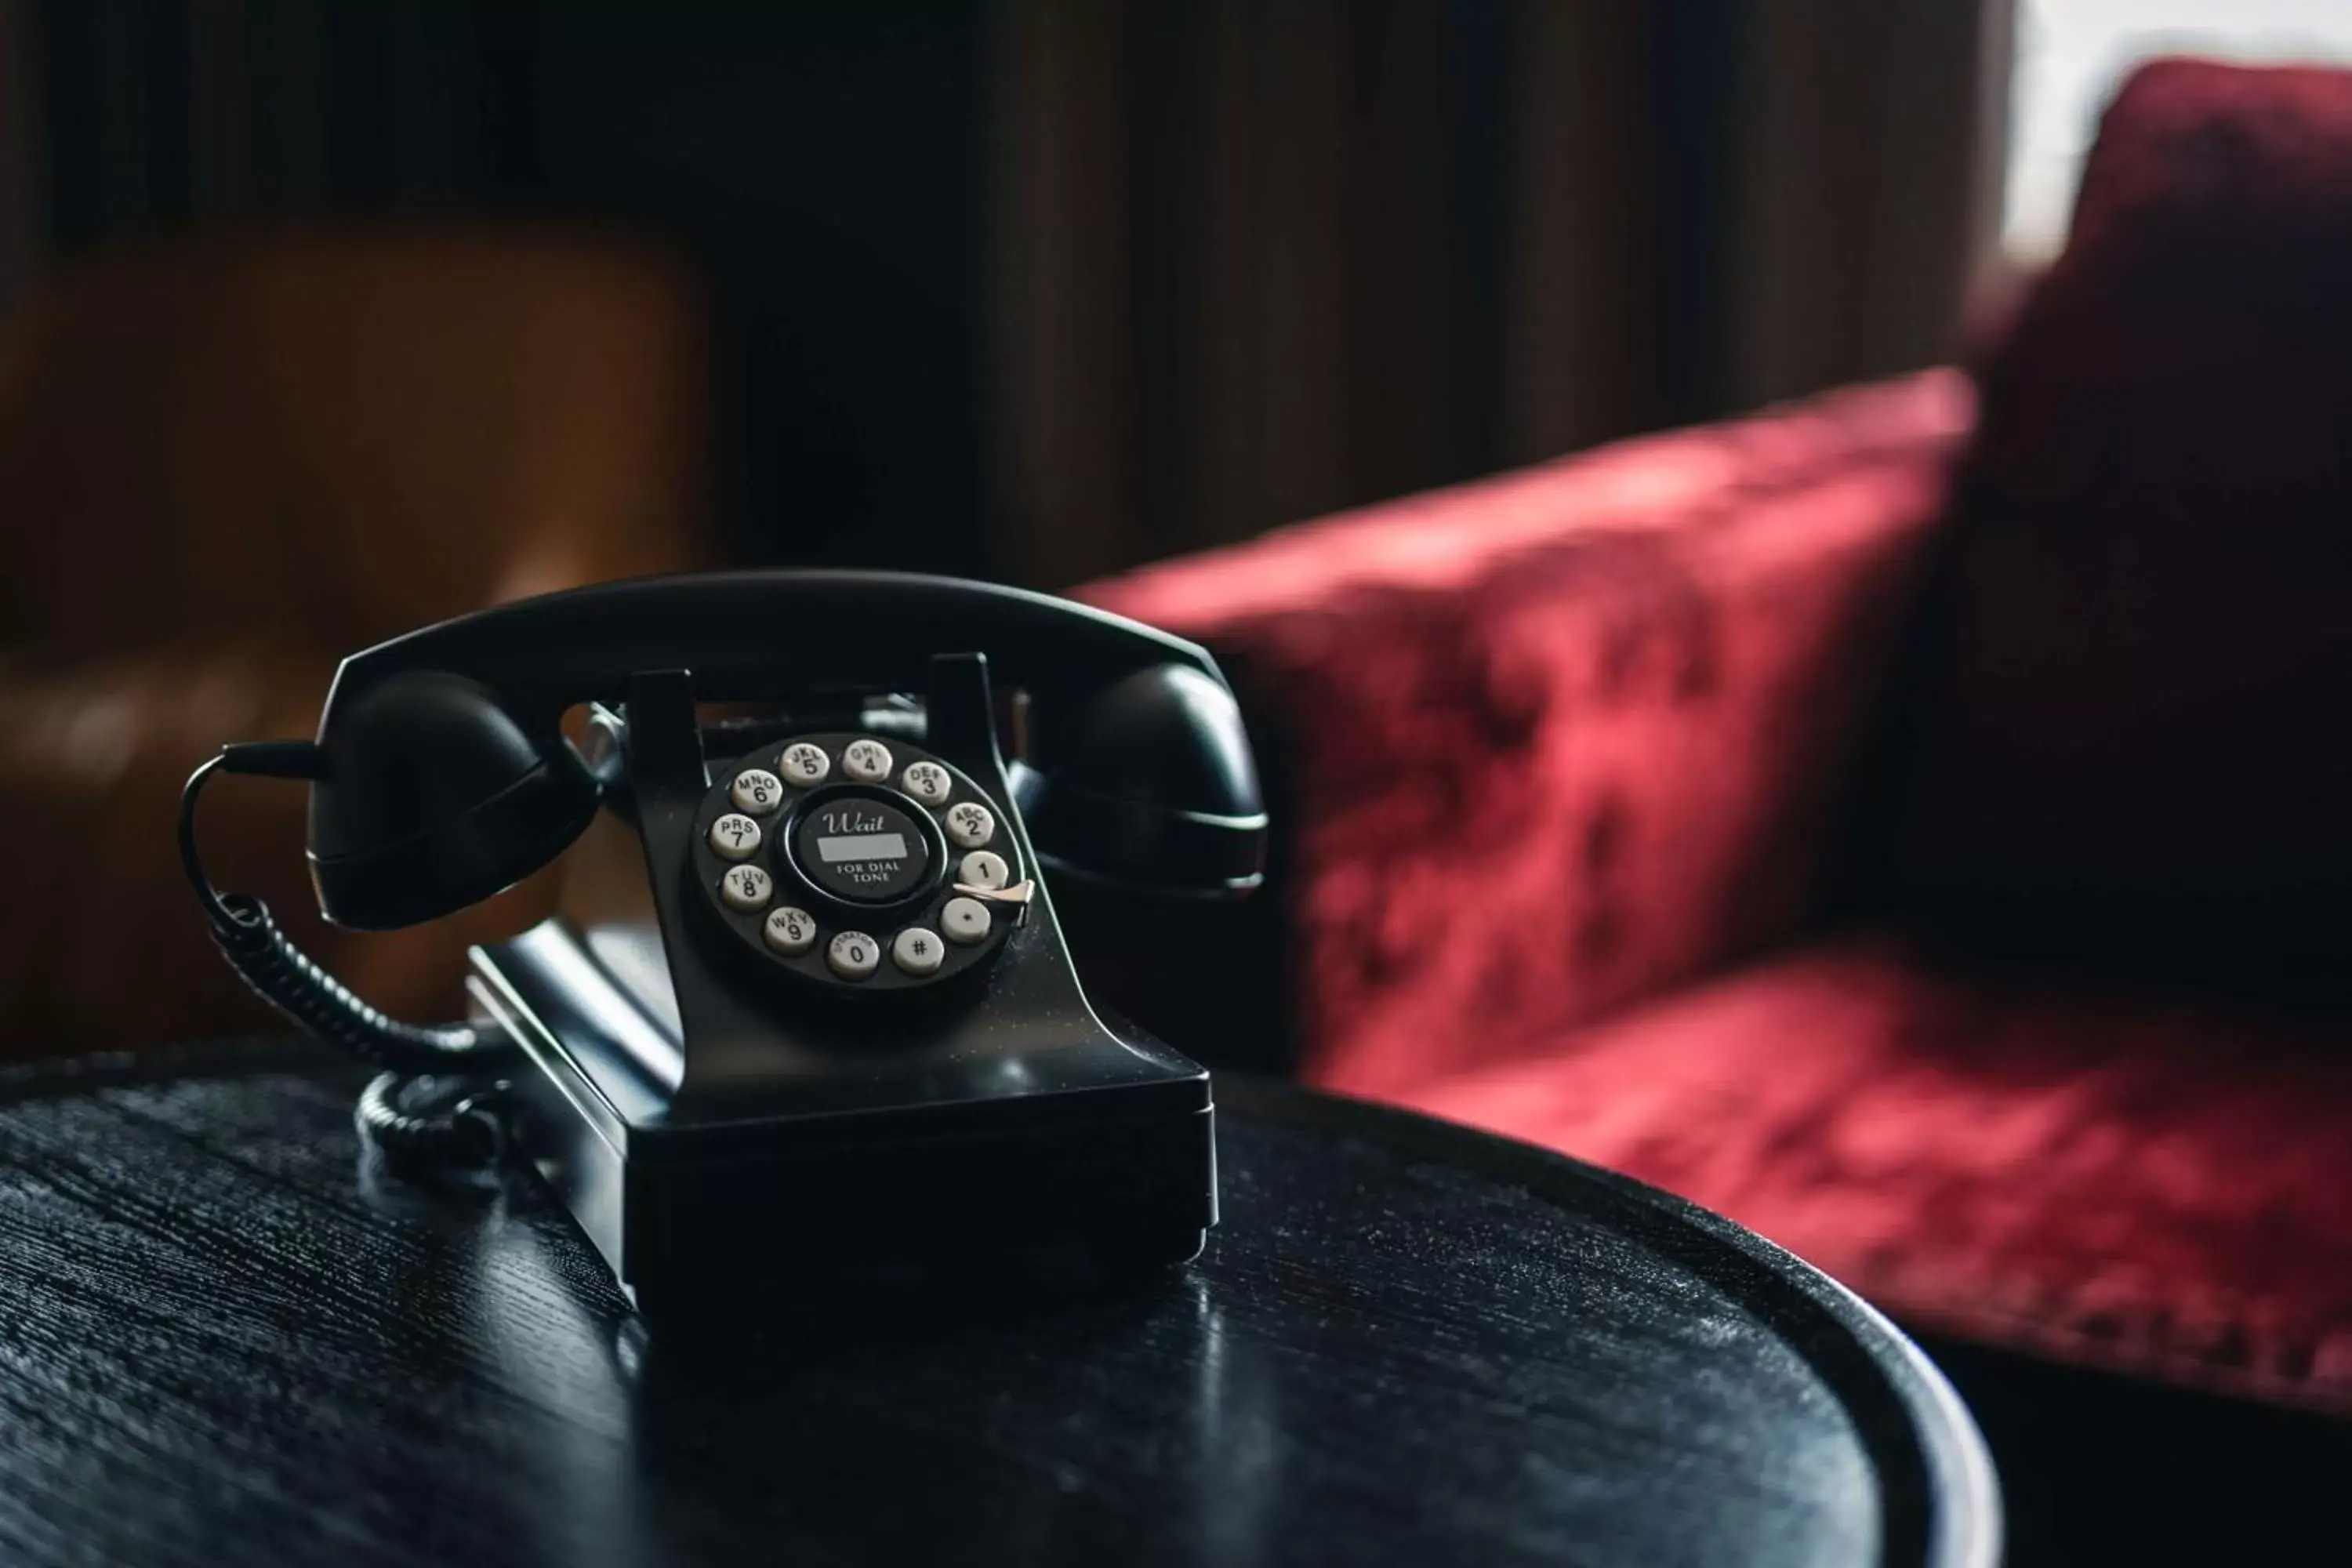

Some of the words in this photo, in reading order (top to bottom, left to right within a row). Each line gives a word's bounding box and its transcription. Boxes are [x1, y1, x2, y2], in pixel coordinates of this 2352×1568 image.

[792, 746, 821, 763] JKL
[804, 759, 818, 775] 5
[865, 757, 876, 771] 4
[910, 766, 941, 780] DEF
[738, 775, 775, 790] MNO
[922, 779, 936, 795] 3
[753, 787, 768, 803] 6
[822, 812, 884, 833] Wait
[955, 807, 984, 822] ABC
[720, 818, 753, 833] PRS
[967, 821, 981, 836] 2
[731, 830, 743, 848] 7
[837, 863, 863, 874] FOR
[869, 861, 899, 873] DIAL
[978, 862, 989, 879] 1
[730, 870, 764, 885] TUV
[854, 872, 890, 883] TONE
[743, 881, 756, 898] 8
[771, 912, 808, 928] WXY
[788, 924, 802, 941] 9
[850, 946, 865, 964] 0
[912, 940, 927, 956] #
